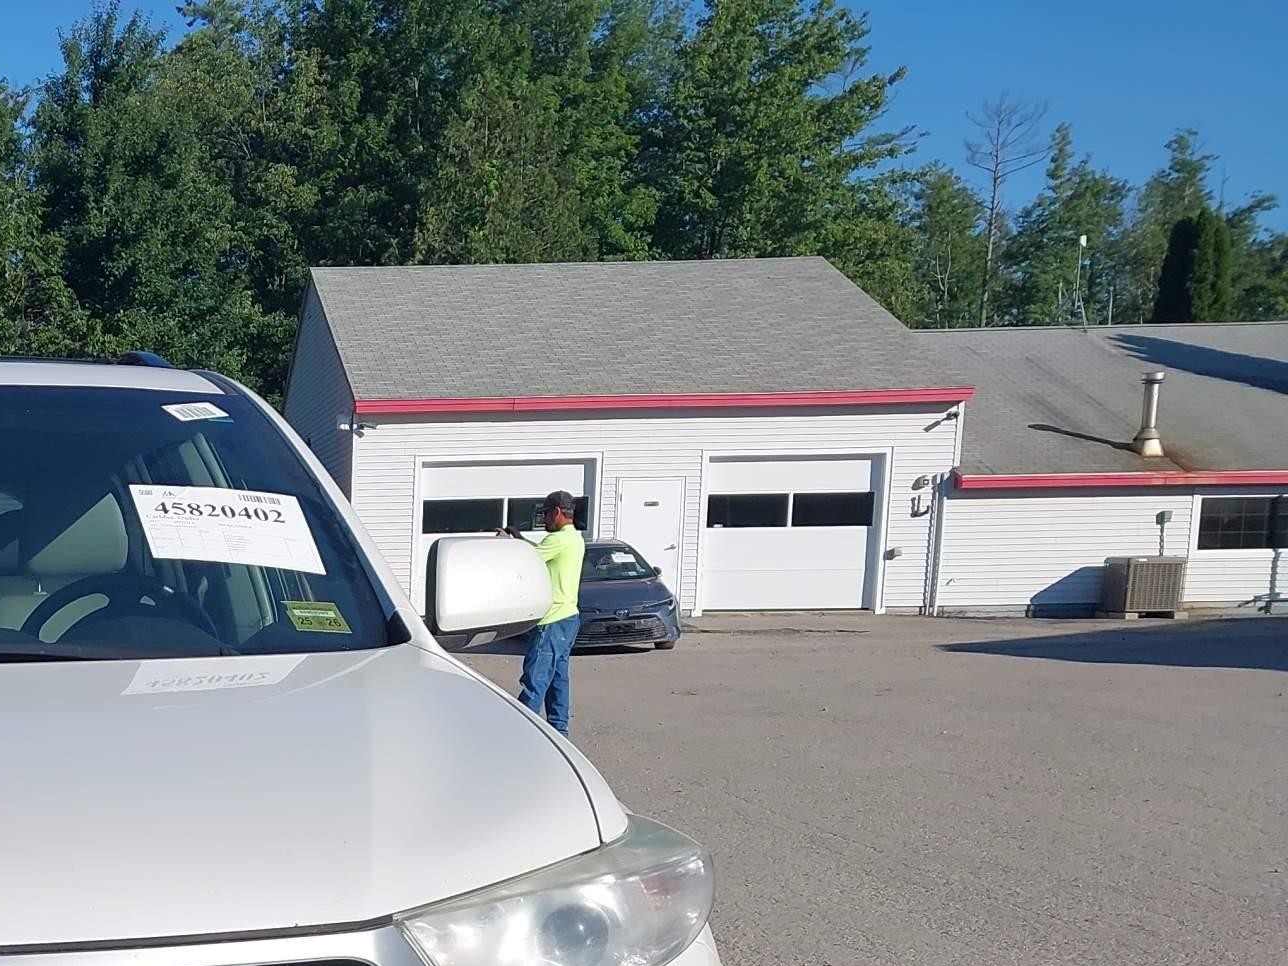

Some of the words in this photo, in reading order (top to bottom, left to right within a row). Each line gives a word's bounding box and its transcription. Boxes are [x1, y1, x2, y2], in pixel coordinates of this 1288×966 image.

[154, 501, 286, 524] 45820402
[298, 617, 313, 626] 25
[326, 618, 342, 627] 26
